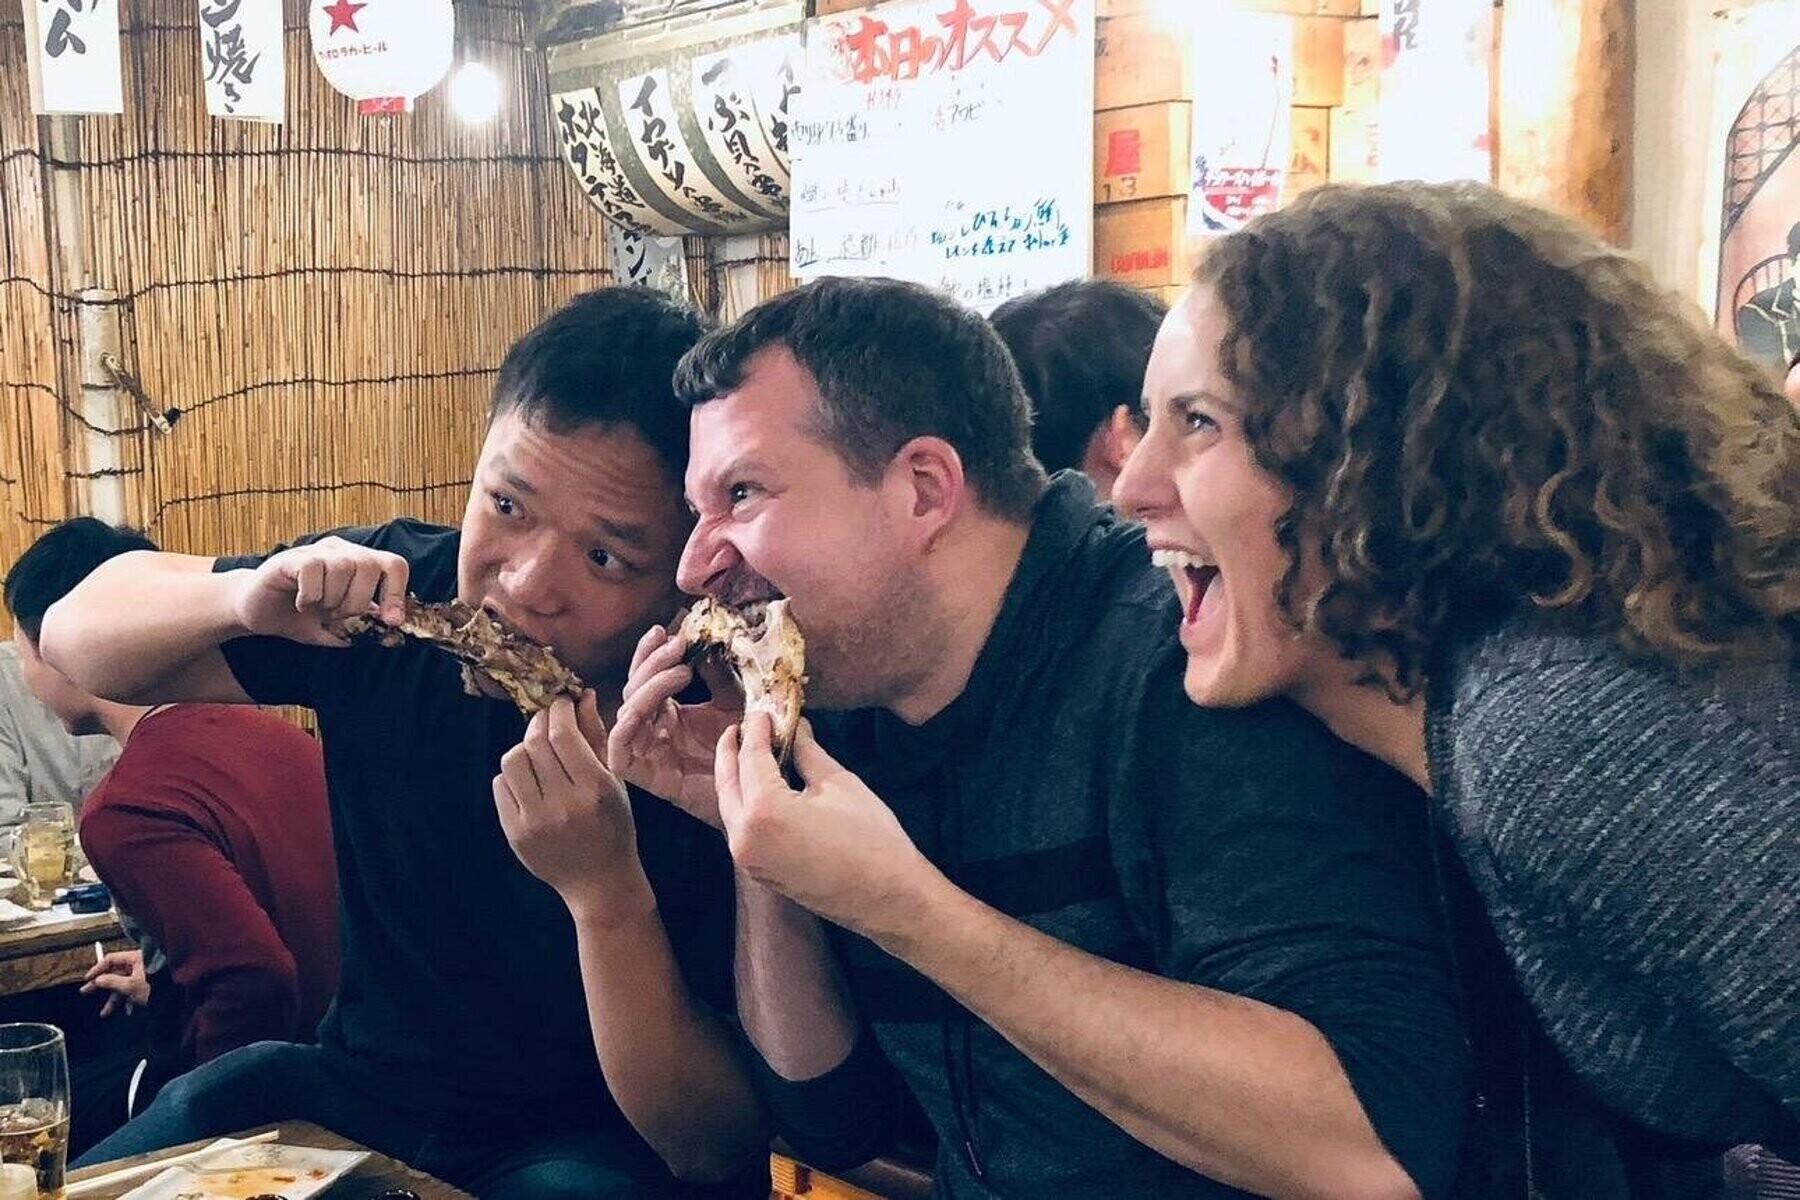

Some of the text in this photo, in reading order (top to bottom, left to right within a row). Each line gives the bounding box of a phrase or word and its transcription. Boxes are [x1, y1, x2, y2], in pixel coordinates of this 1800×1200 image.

[846, 0, 1077, 84] 本日のオススメ
